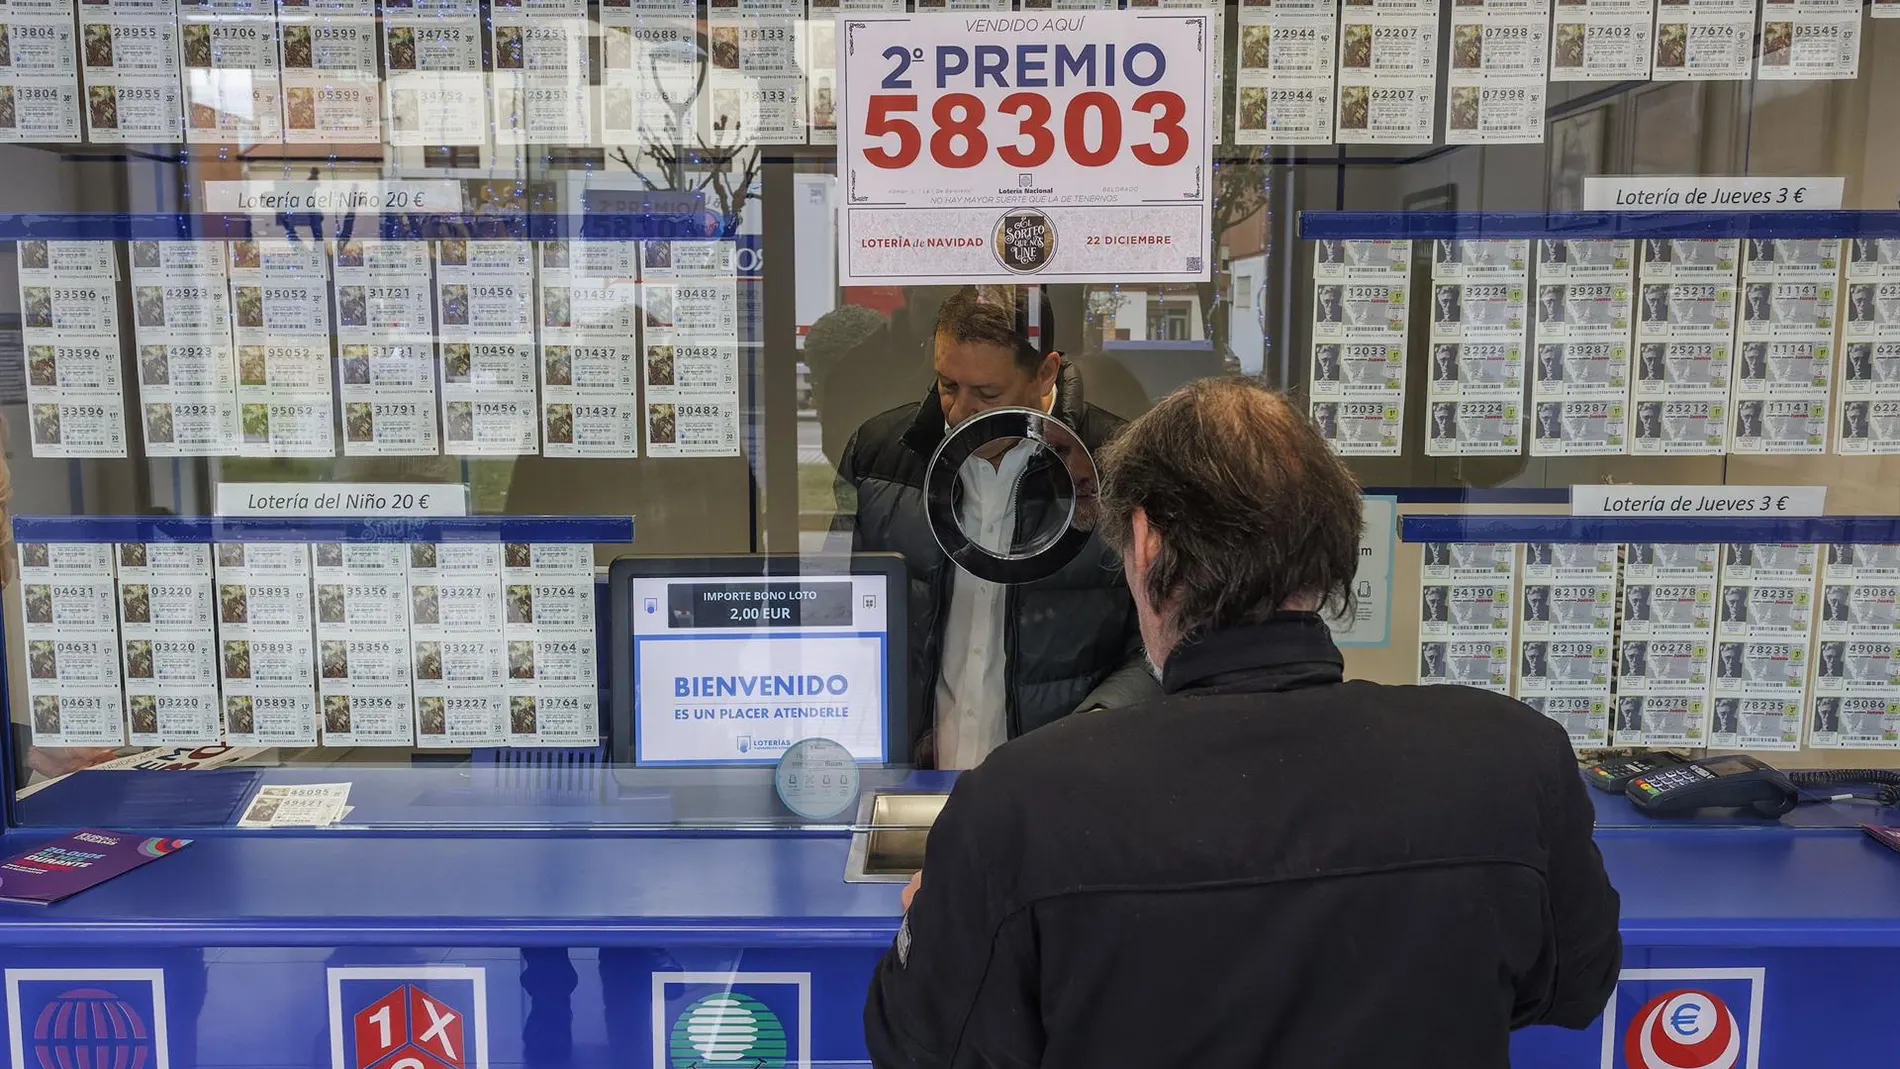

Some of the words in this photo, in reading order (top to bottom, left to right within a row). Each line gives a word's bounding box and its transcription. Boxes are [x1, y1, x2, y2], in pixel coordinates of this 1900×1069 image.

[965, 19, 1039, 33] VENDIDO
[1042, 16, 1085, 32] AQUÍ
[12, 27, 54, 37] 13804
[115, 27, 156, 37] 28955
[213, 28, 256, 38] 41706
[315, 28, 356, 38] 05599
[418, 29, 460, 40] 34752
[635, 29, 677, 40] 00688
[743, 29, 784, 40] 18133
[1273, 29, 1315, 39] 22944
[1375, 28, 1417, 38] 62207
[1485, 28, 1528, 38] 07998
[1588, 27, 1630, 36] 57402
[1690, 27, 1733, 36] 77676
[1795, 26, 1838, 35] 05545
[881, 45, 924, 89] 2º
[935, 42, 1166, 89] PREMIO
[17, 89, 58, 99] 13804
[118, 89, 160, 99] 28955
[318, 90, 360, 100] 05599
[1271, 90, 1312, 100] 22944
[1372, 90, 1414, 99] 62207
[1482, 90, 1525, 99] 07998
[862, 90, 1190, 169] 58303
[238, 191, 300, 208] Lotería
[307, 191, 333, 208] del
[339, 191, 380, 208] Niño
[386, 191, 408, 208] 20
[413, 191, 425, 208] €
[930, 196, 942, 204] NO
[945, 196, 964, 204] HAY
[964, 196, 994, 204] MAYOR
[996, 195, 1027, 204] SUERTE
[1028, 195, 1047, 204] QUE
[1048, 196, 1060, 204] LA
[1074, 194, 1118, 203] TENERNOS
[1616, 187, 1679, 205] Lotería
[1685, 188, 1706, 205] de
[1711, 188, 1771, 205] Jueves
[1776, 188, 1788, 204] 3
[1792, 187, 1807, 204] €
[1004, 225, 1045, 244] SORTEO
[862, 236, 911, 248] LOTERÍA
[912, 239, 925, 248] de
[927, 238, 984, 248] NAVIDAD
[1014, 240, 1028, 248] QUE
[1030, 236, 1044, 248] NOS
[1086, 236, 1100, 246] 22
[1104, 234, 1171, 246] DICIEMBRE
[1010, 246, 1037, 264] UNE
[54, 289, 96, 299] 33596
[166, 289, 208, 299] 42923
[265, 289, 306, 299] 95052
[472, 287, 513, 297] 10456
[675, 288, 717, 299] 90482
[1349, 287, 1389, 297] 12033
[1466, 286, 1507, 296] 32224
[1570, 286, 1612, 295] 39287
[1674, 286, 1715, 296] 25212
[1778, 286, 1817, 295] 11141
[58, 348, 99, 358] 33596
[171, 347, 212, 357] 42923
[268, 348, 309, 358] 95052
[474, 346, 514, 356] 10456
[575, 347, 616, 358] 01437
[676, 347, 718, 358] 90482
[1347, 346, 1386, 356] 12033
[1464, 346, 1504, 355] 32224
[1569, 345, 1609, 355] 39287
[1671, 345, 1711, 354] 25212
[1773, 344, 1813, 354] 11141
[62, 407, 104, 416] 33596
[175, 405, 216, 415] 42923
[271, 407, 313, 416] 95052
[375, 404, 416, 414] 31791
[476, 404, 517, 414] 10456
[576, 406, 617, 416] 01437
[678, 405, 719, 415] 90482
[1344, 405, 1383, 414] 12033
[1462, 404, 1502, 413] 32224
[1567, 404, 1607, 413] 39287
[1667, 404, 1708, 413] 25212
[1769, 403, 1808, 413] 11141
[248, 493, 309, 509] Lotería
[315, 493, 341, 509] del
[346, 493, 386, 509] Niño
[392, 494, 414, 509] 20
[418, 494, 431, 509] €
[1603, 496, 1664, 513] Lotería
[1670, 497, 1692, 513] de
[1696, 496, 1754, 513] Jueves
[1759, 496, 1771, 511] 3
[1776, 495, 1790, 511] €
[54, 586, 94, 596] 04631
[152, 586, 192, 596] 03220
[250, 587, 290, 596] 05893
[347, 587, 387, 596] 35356
[441, 587, 481, 597] 93227
[536, 587, 575, 596] 19764
[703, 592, 752, 601] IMPORTE
[754, 591, 786, 601] BONO
[788, 591, 817, 600] LOTO
[1453, 588, 1493, 597] 54190
[1555, 588, 1595, 597] 82109
[1655, 587, 1696, 596] 06278
[1753, 589, 1794, 598] 78235
[1854, 588, 1896, 597] 49086
[730, 608, 759, 622] 2,00
[762, 608, 791, 620] EUR
[58, 642, 97, 652] 04631
[155, 642, 195, 652] 03220
[252, 642, 292, 652] 05893
[350, 643, 389, 652] 35356
[444, 643, 484, 653] 93227
[538, 643, 577, 652] 19764
[1451, 644, 1491, 653] 54190
[1552, 644, 1592, 653] 82109
[1651, 643, 1692, 652] 06278
[1749, 645, 1789, 654] 78235
[1850, 644, 1891, 653] 49086
[674, 674, 848, 698] BIENVENIDO
[61, 698, 100, 708] 04631
[158, 698, 198, 708] 03220
[255, 698, 296, 708] 05893
[352, 698, 392, 707] 35356
[447, 699, 487, 708] 93227
[540, 698, 578, 707] 19764
[1549, 700, 1590, 708] 82109
[1647, 698, 1688, 708] 06278
[1744, 700, 1784, 710] 78235
[1845, 699, 1885, 709] 49086
[675, 709, 689, 720] ES
[694, 708, 715, 720] UN
[720, 708, 769, 719] PLACER
[774, 707, 848, 718] ATENDERLE
[754, 738, 791, 746] LOTERÍAS
[24, 854, 93, 868] DURANTE
[1670, 1003, 1701, 1036] €
[369, 1005, 391, 1049] 1
[419, 998, 457, 1061] X
